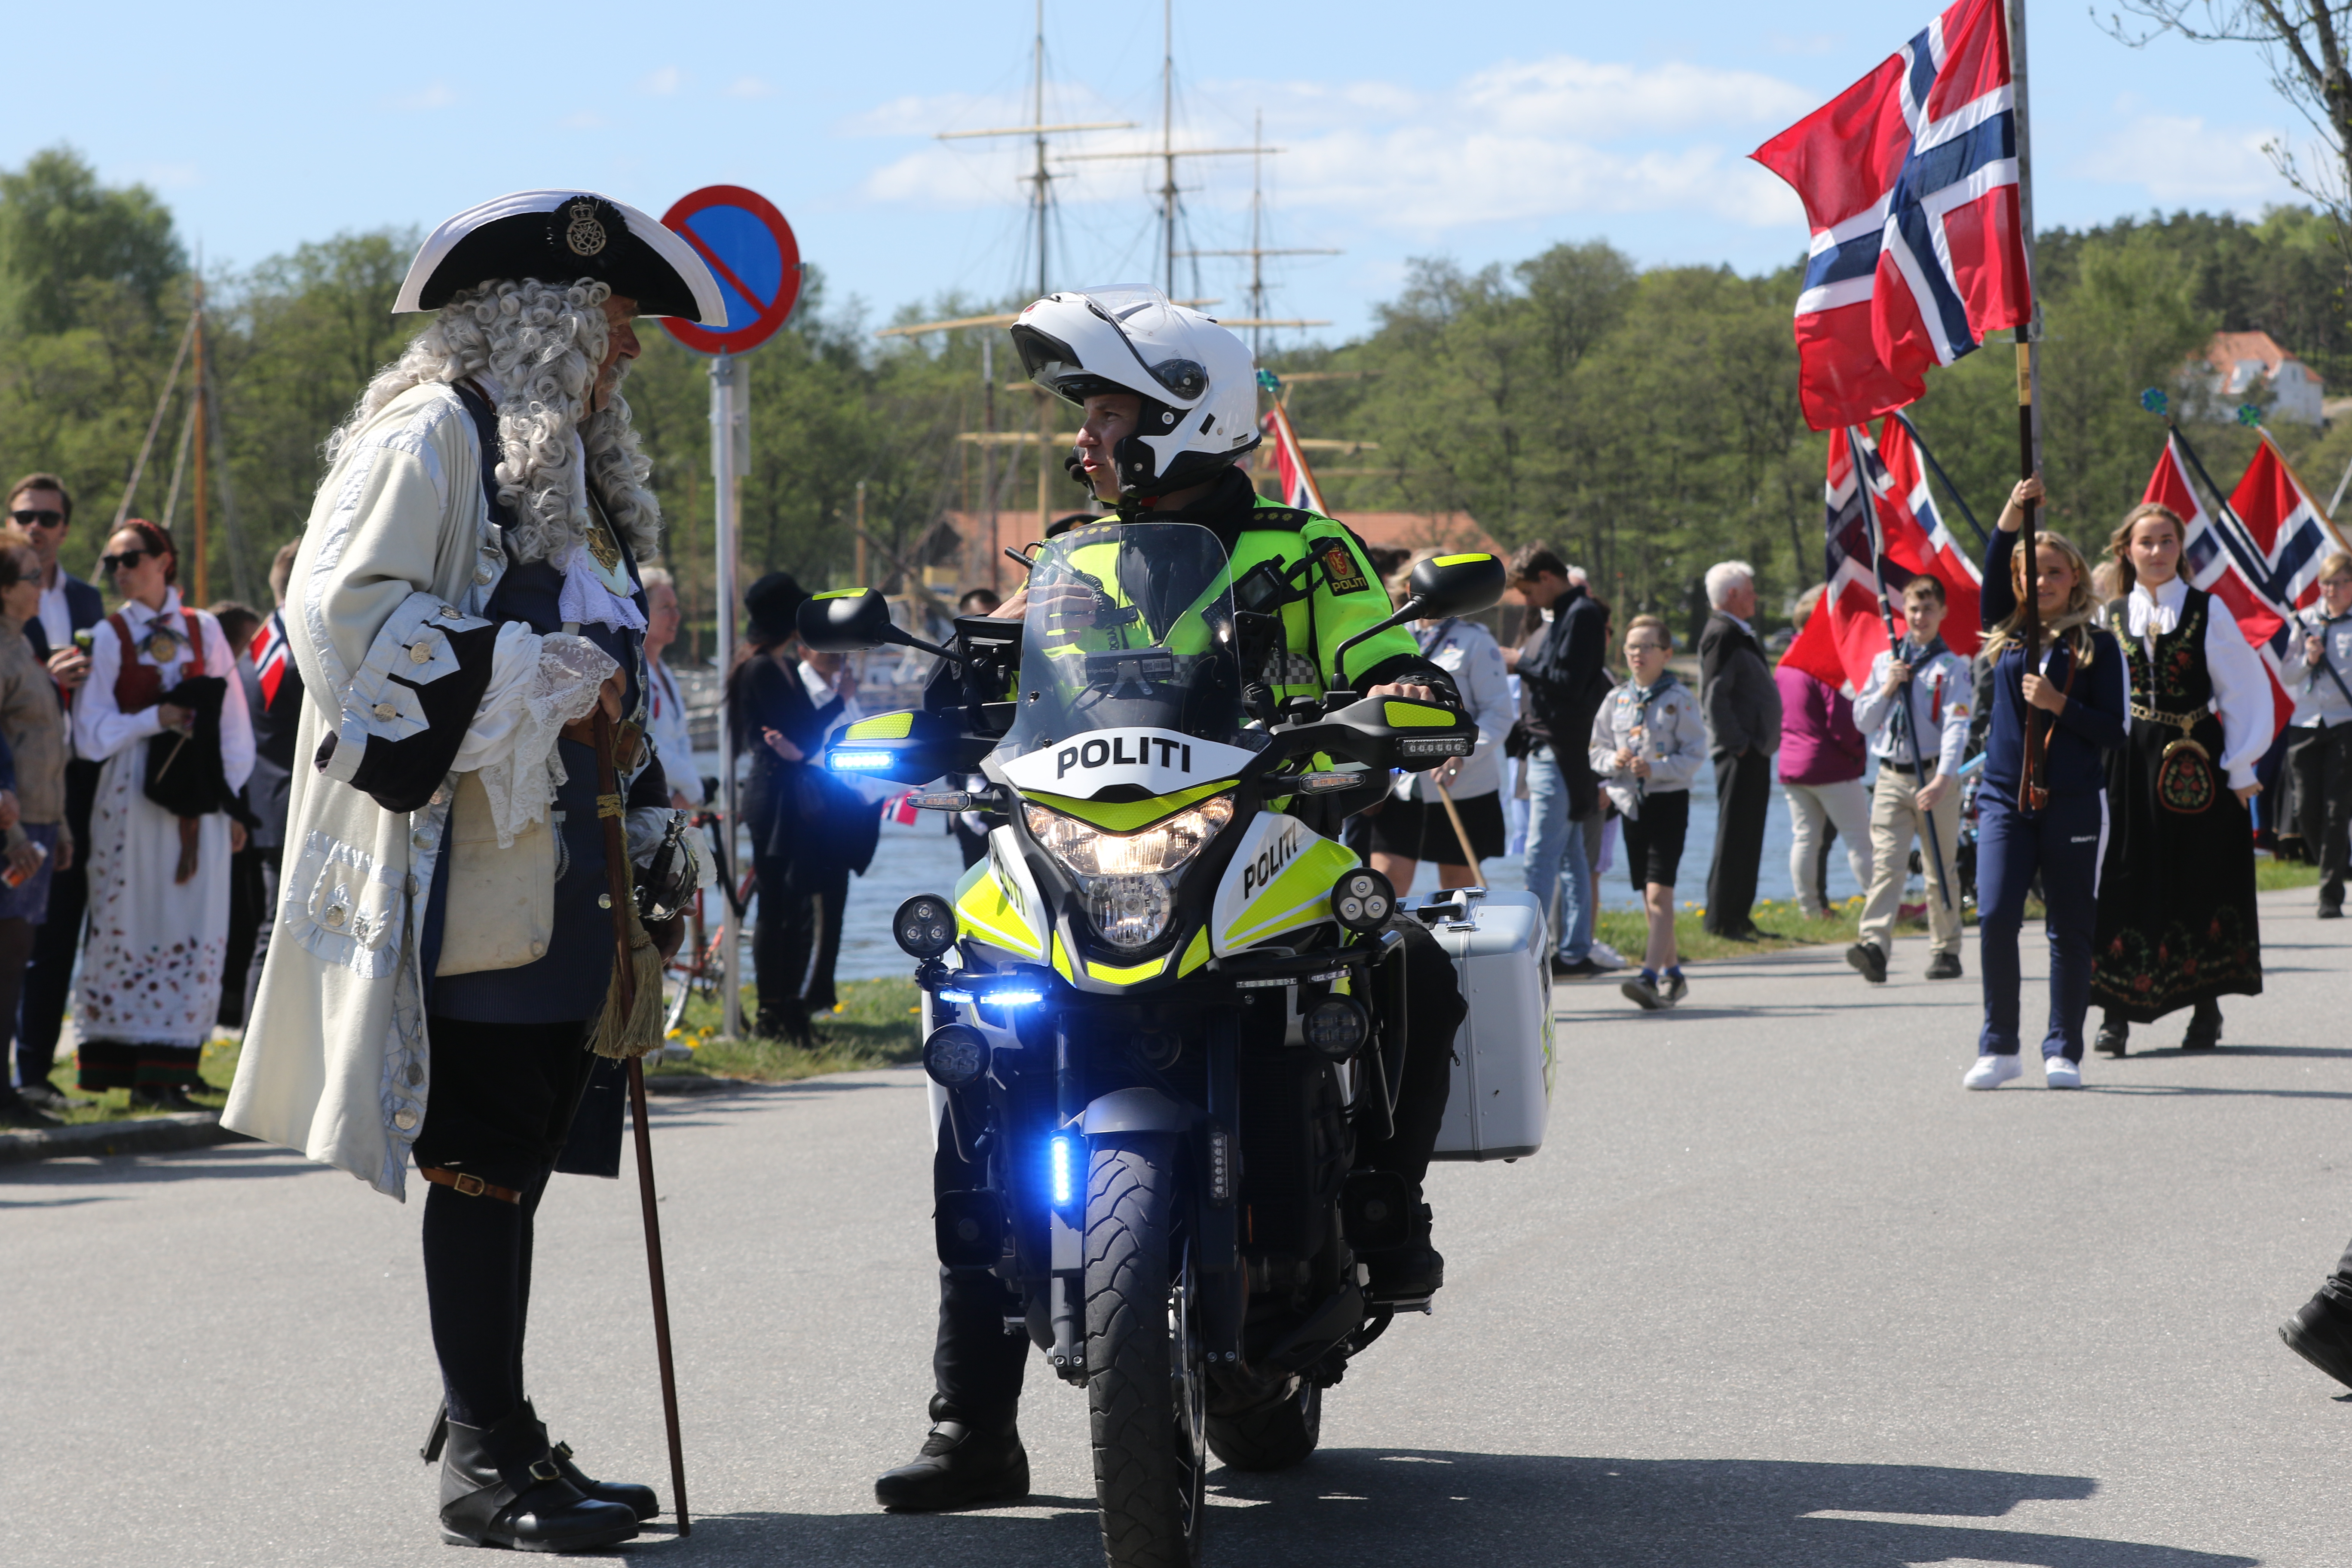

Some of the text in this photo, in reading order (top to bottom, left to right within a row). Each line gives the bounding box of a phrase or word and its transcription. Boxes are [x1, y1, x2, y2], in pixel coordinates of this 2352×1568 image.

[1332, 577, 1367, 591] POLITI
[1057, 737, 1190, 780] POLITI
[1244, 821, 1297, 900] POLITI
